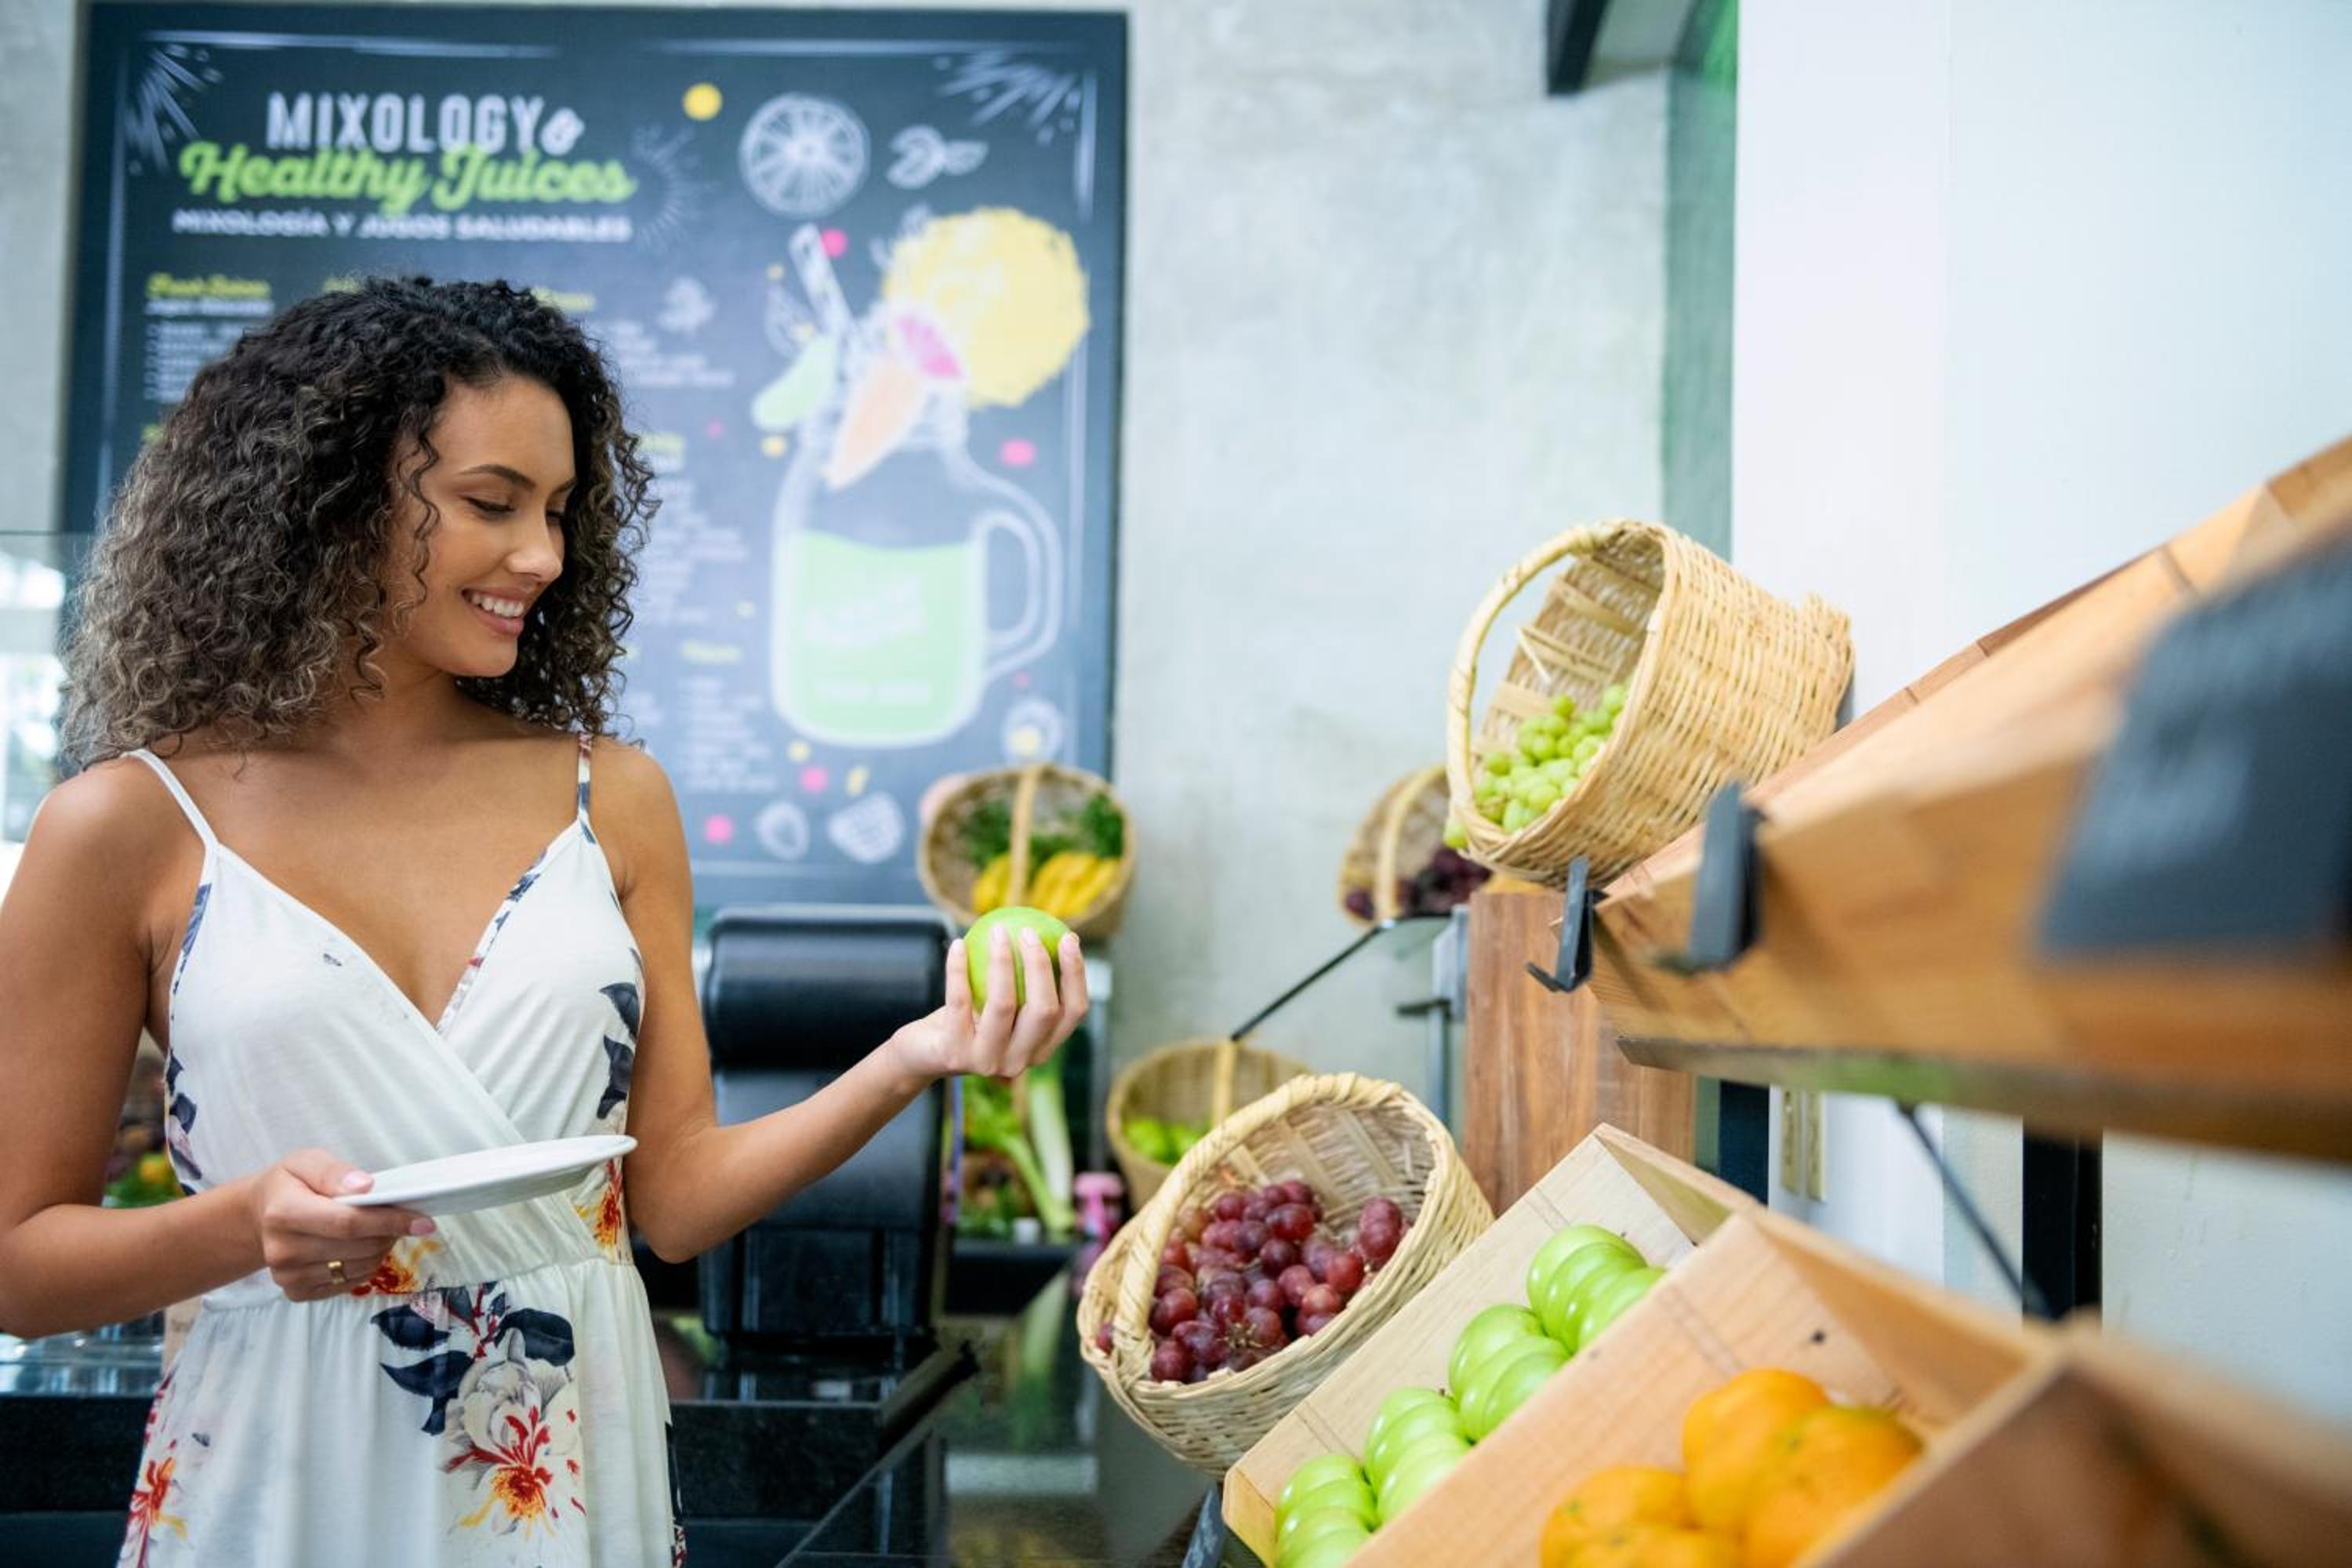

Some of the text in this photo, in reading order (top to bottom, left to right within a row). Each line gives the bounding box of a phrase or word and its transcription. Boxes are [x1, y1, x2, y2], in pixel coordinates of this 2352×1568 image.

[267, 92, 545, 154] MIXOLOGY
[179, 140, 639, 217] Healthy Juices
[329, 212, 355, 238] Y
